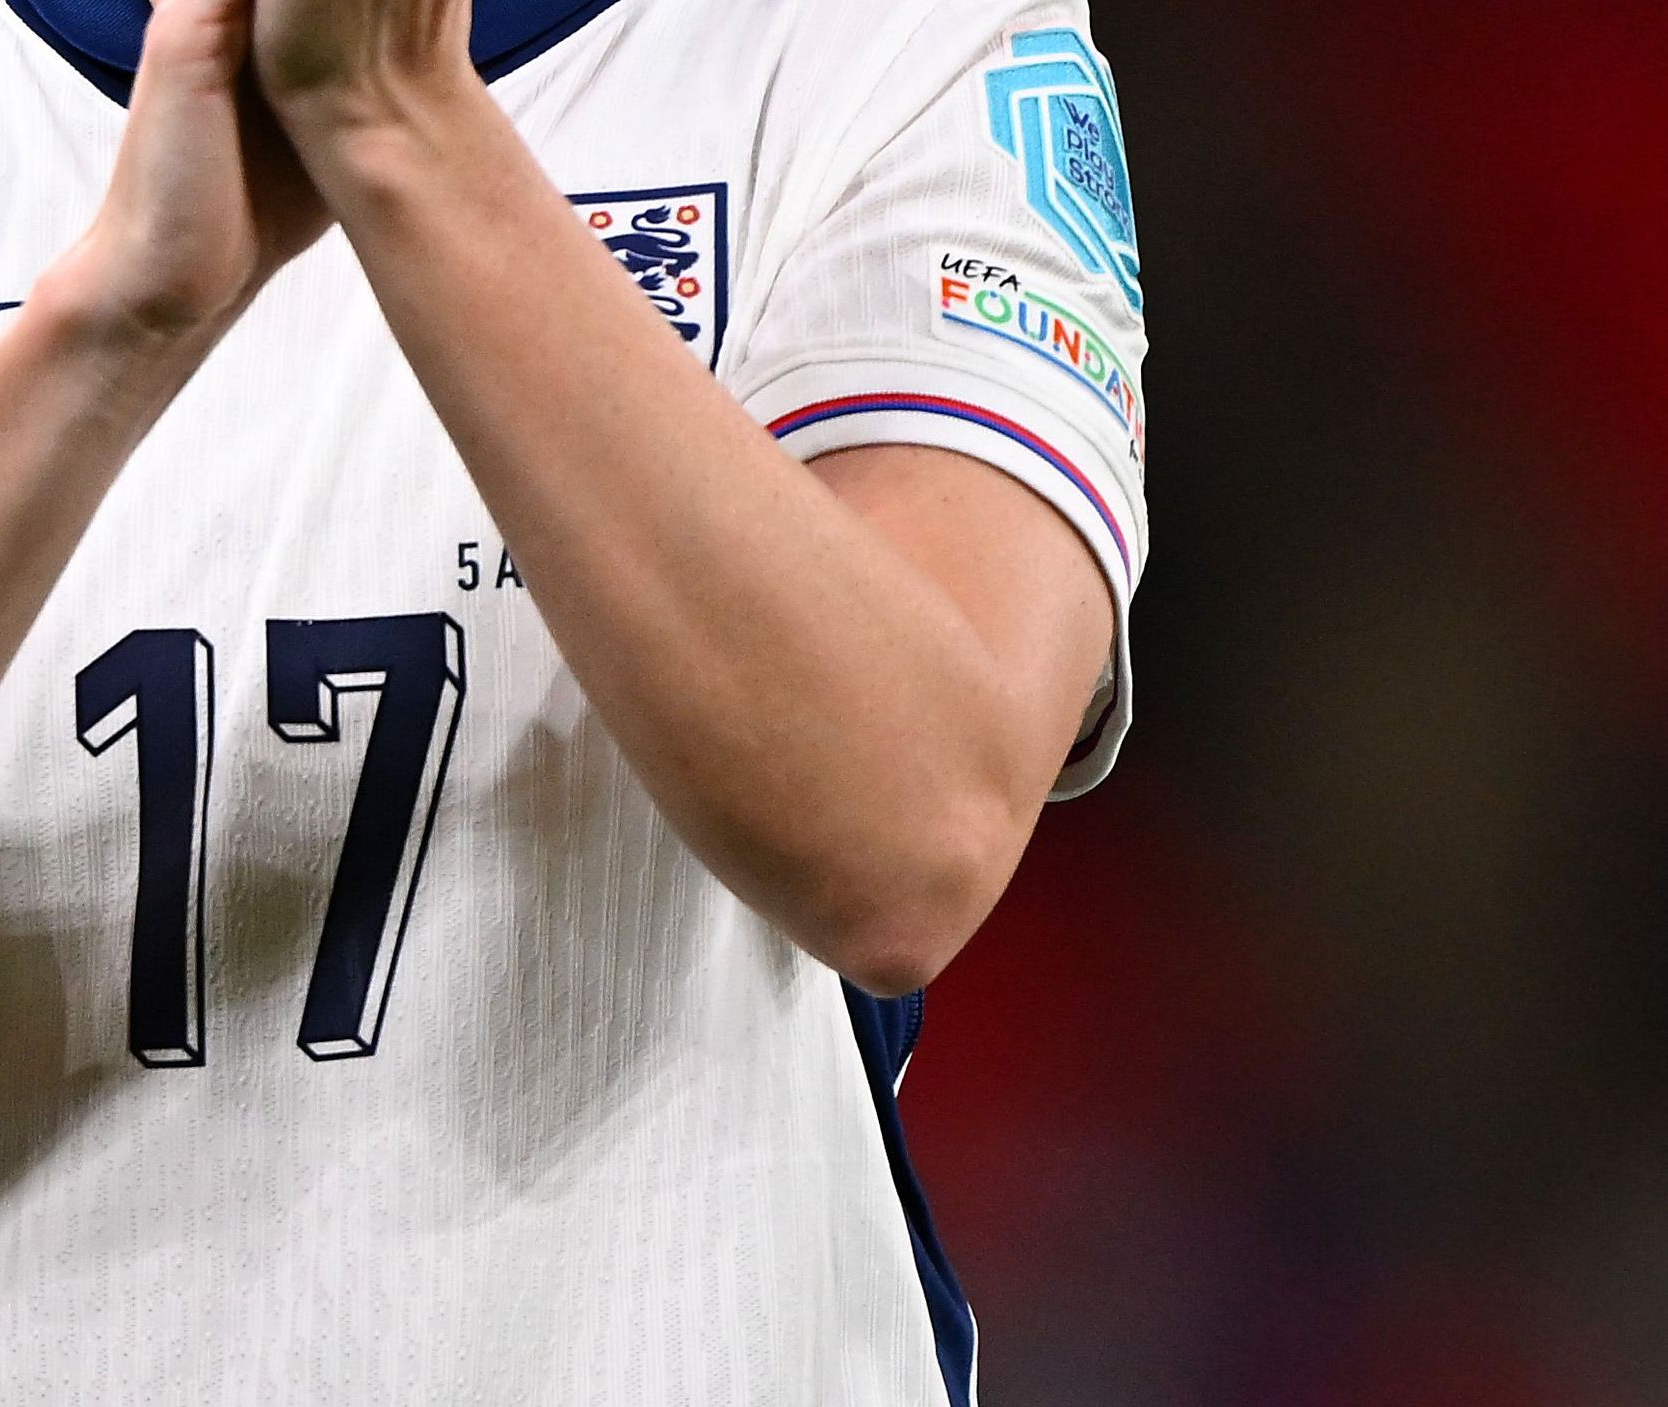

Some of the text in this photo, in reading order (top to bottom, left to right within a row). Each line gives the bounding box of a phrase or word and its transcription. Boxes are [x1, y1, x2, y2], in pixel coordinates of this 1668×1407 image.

[1063, 97, 1101, 145] We
[940, 252, 1022, 292] UEFA
[941, 276, 1143, 440] FOUNDAT
[458, 542, 524, 592] 5 A
[75, 611, 467, 1068] 17
